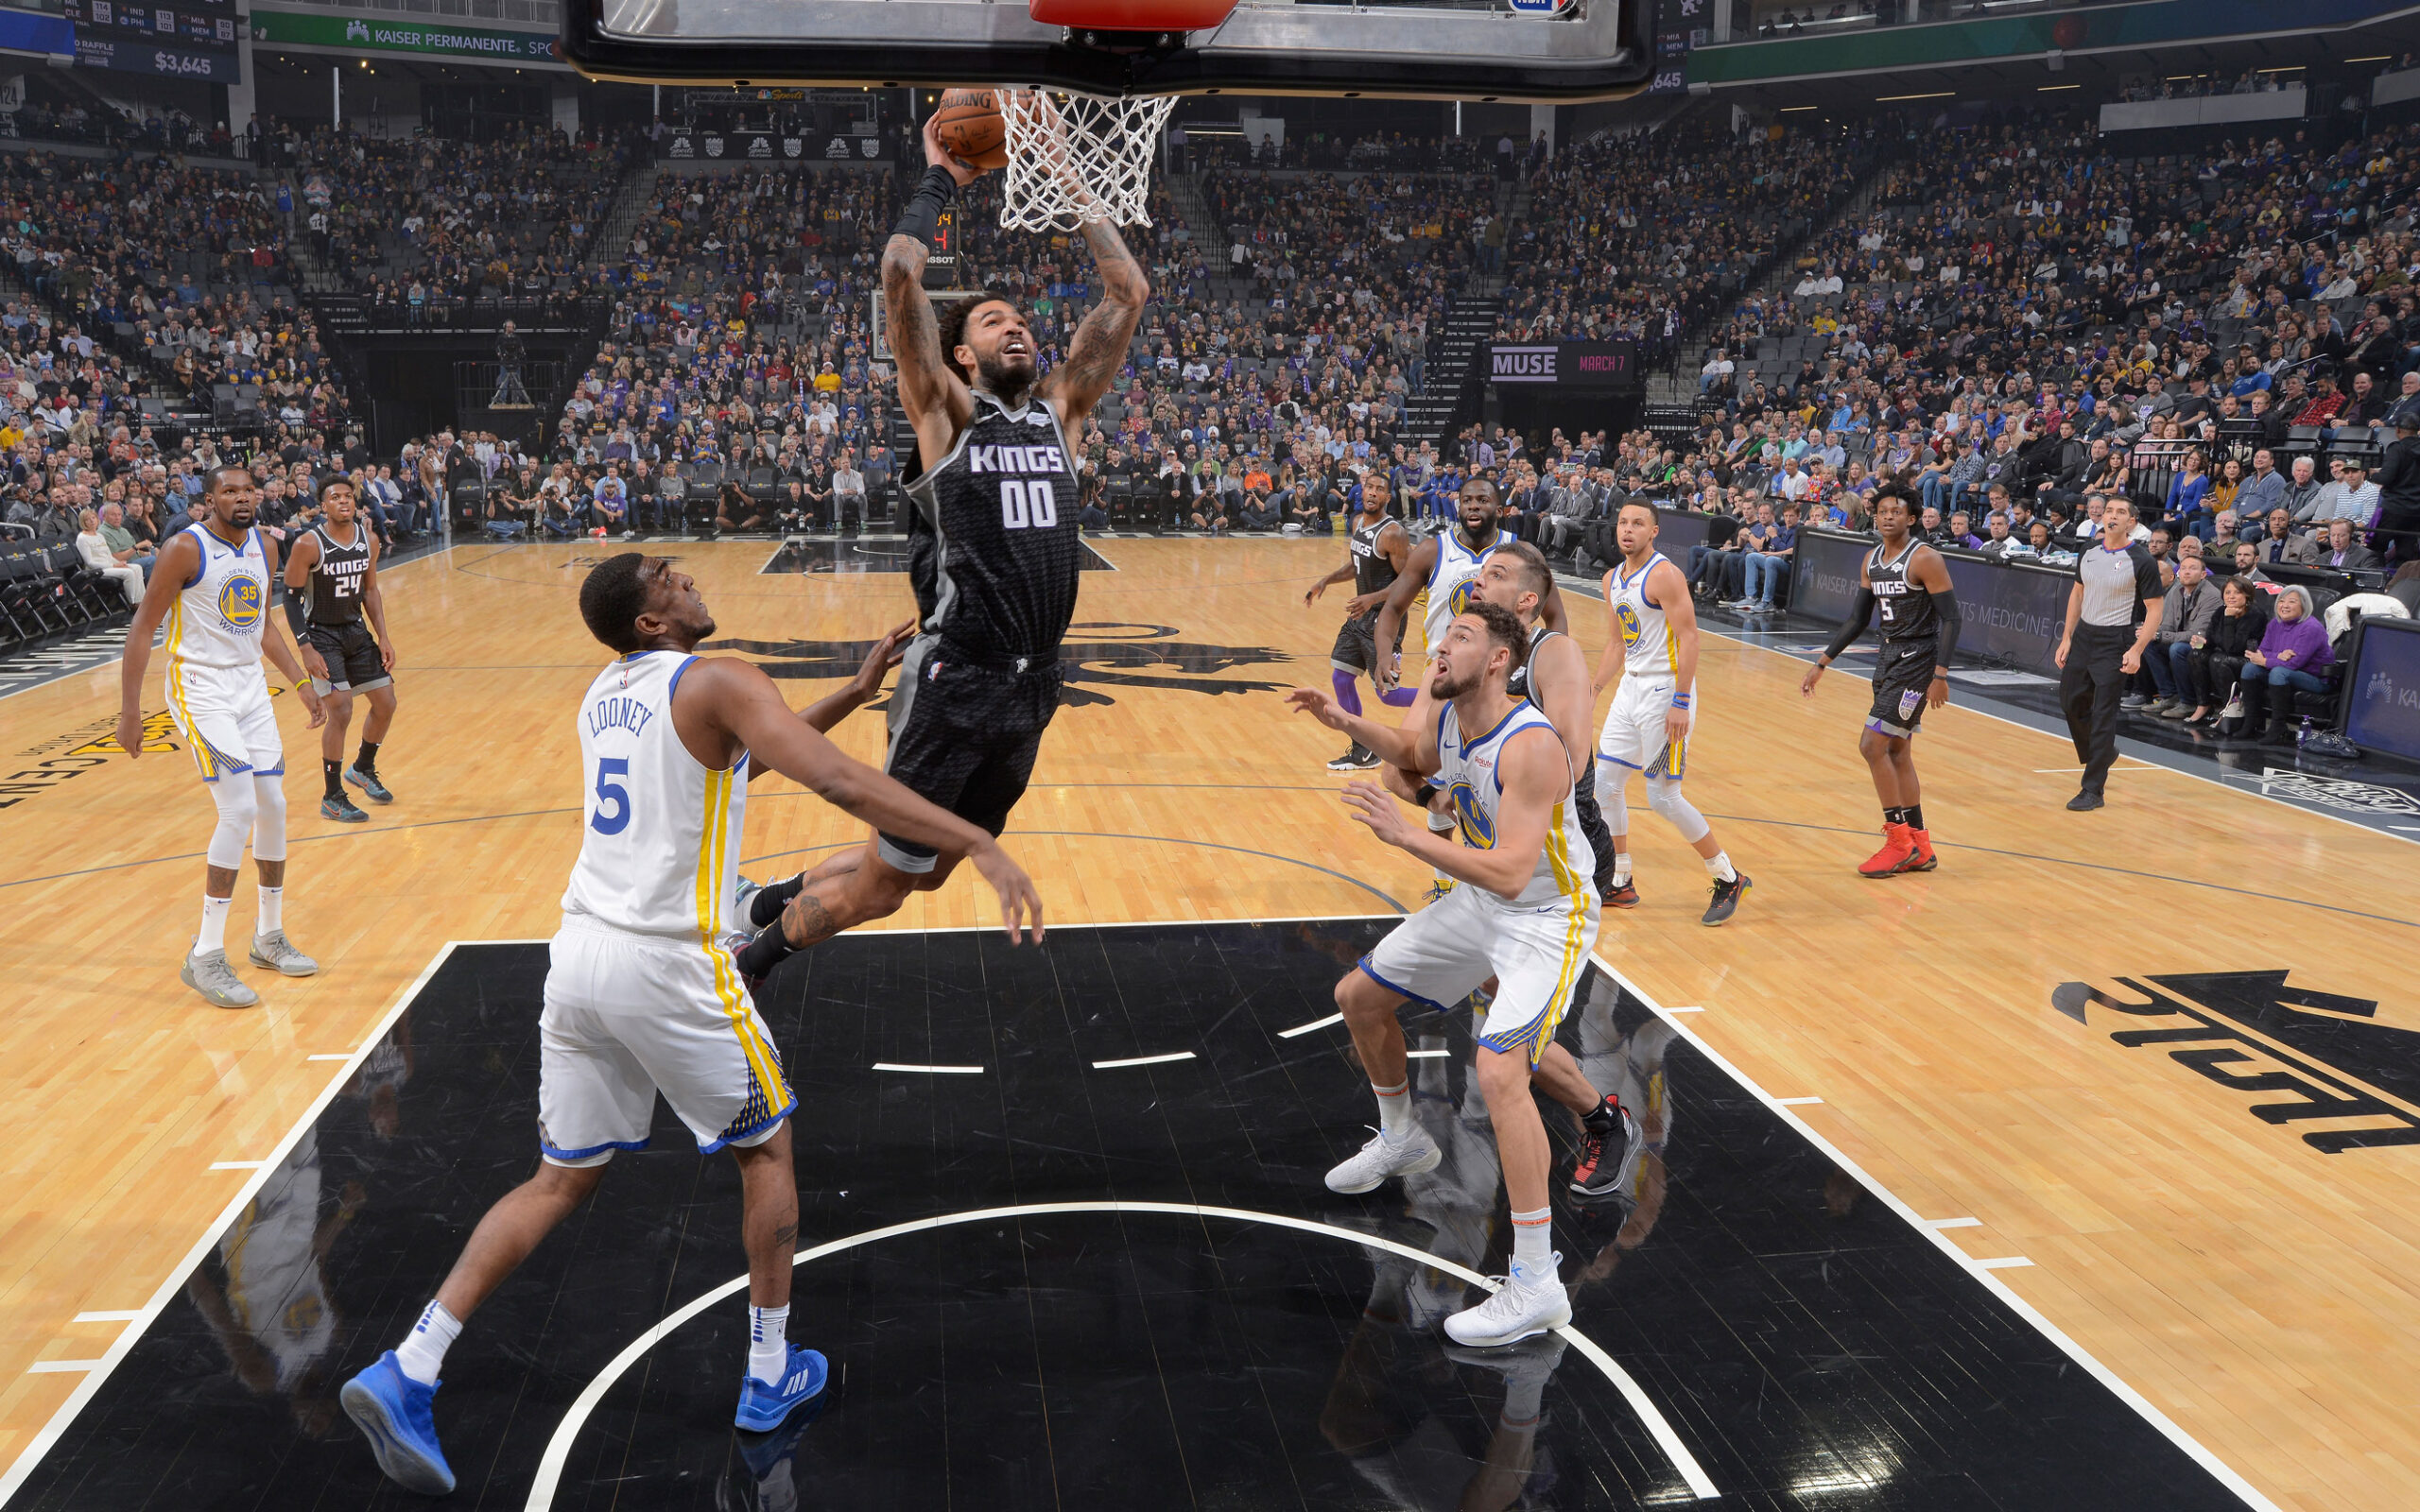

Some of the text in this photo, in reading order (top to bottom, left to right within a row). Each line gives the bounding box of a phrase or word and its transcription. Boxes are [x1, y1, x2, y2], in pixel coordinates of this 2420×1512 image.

[65, 9, 81, 18] CLE
[130, 8, 145, 16] IND
[130, 17, 145, 26] PHI
[159, 12, 171, 21] 113
[191, 17, 205, 26] MIA
[191, 26, 210, 36] MEM
[82, 40, 114, 52] RAFFLE
[375, 29, 421, 45] KAISER
[425, 33, 515, 54] PERMANENTE
[155, 51, 211, 75] $3,645
[771, 90, 803, 101] Sports
[934, 229, 947, 250] 4
[1493, 354, 1556, 374] MUSE
[1580, 355, 1625, 371] MARCH 7
[969, 445, 1064, 472] KINGS
[1000, 480, 1057, 529] 00
[323, 558, 370, 576] KINGS
[1353, 554, 1360, 575] 9
[218, 568, 262, 587] GOLDEN STATE
[336, 575, 362, 597] 24
[1448, 573, 1478, 590] GOLDEN
[1817, 573, 1847, 595] KAISER
[240, 585, 257, 601] 35
[1623, 610, 1634, 625] 30
[1880, 597, 1894, 621] 5
[218, 617, 262, 637] WARRIORS
[1979, 606, 2050, 638] MEDICINE
[588, 697, 653, 738] LOONEY
[591, 756, 631, 835] 5
[1470, 799, 1481, 821] 11
